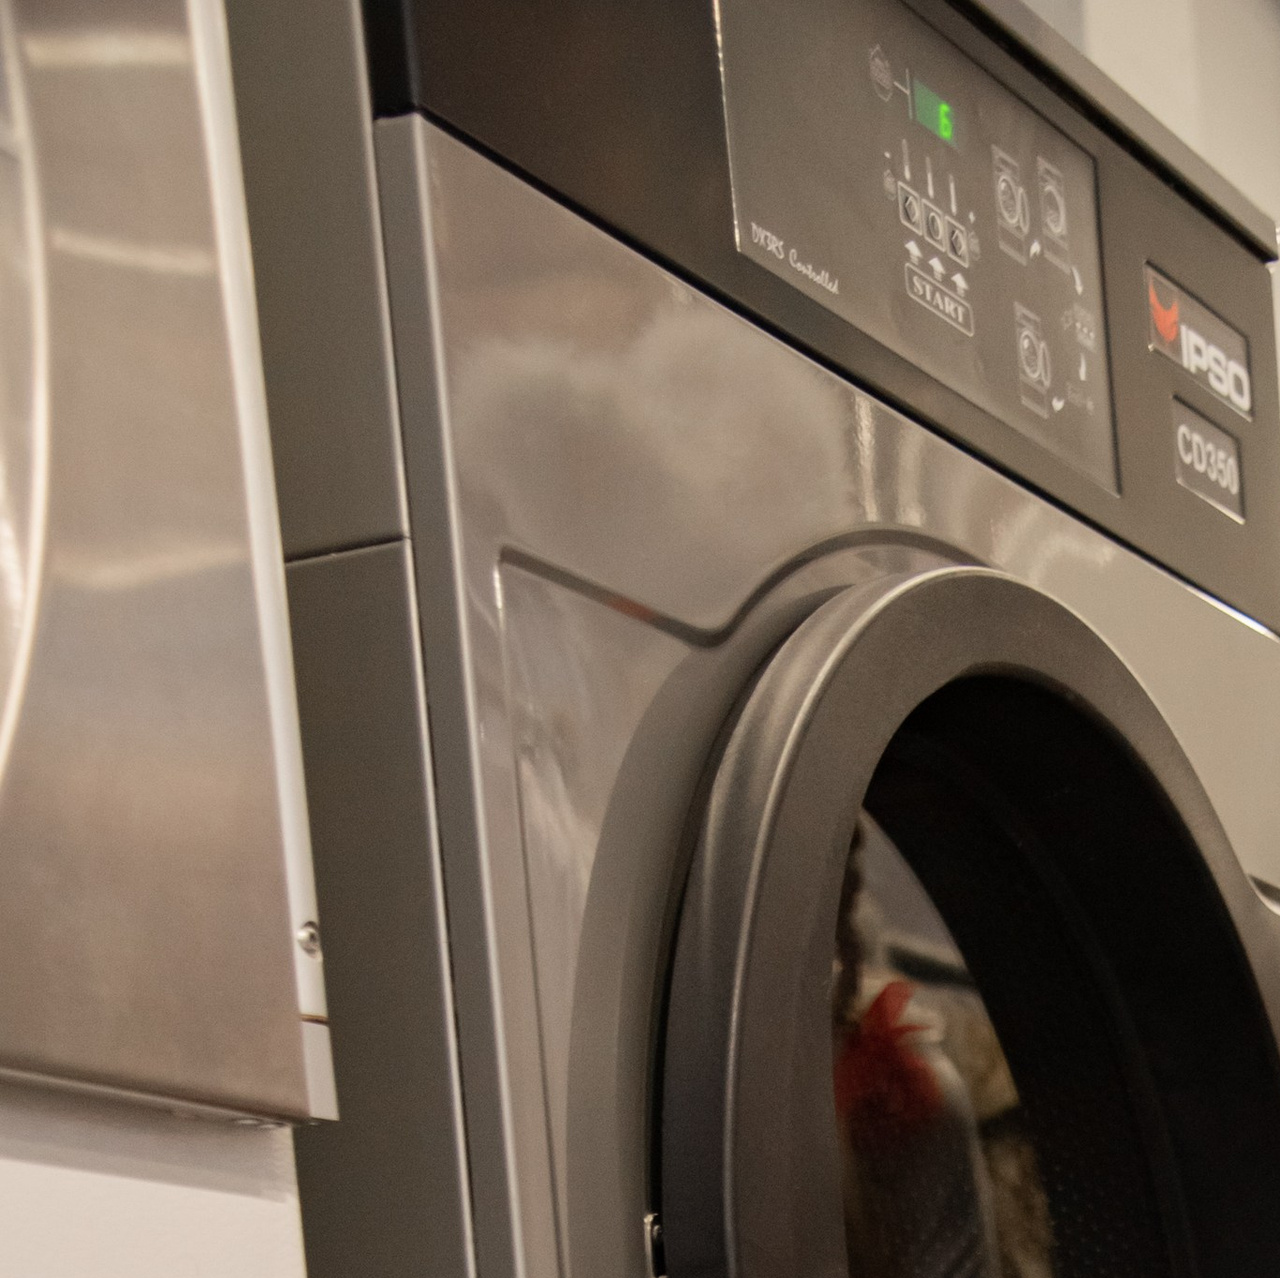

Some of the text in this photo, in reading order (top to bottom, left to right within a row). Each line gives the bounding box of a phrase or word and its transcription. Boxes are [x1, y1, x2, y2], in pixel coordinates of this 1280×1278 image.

[938, 103, 952, 139] 6
[912, 275, 965, 322] START
[1180, 324, 1251, 412] IPSO
[1177, 424, 1239, 495] CD350
